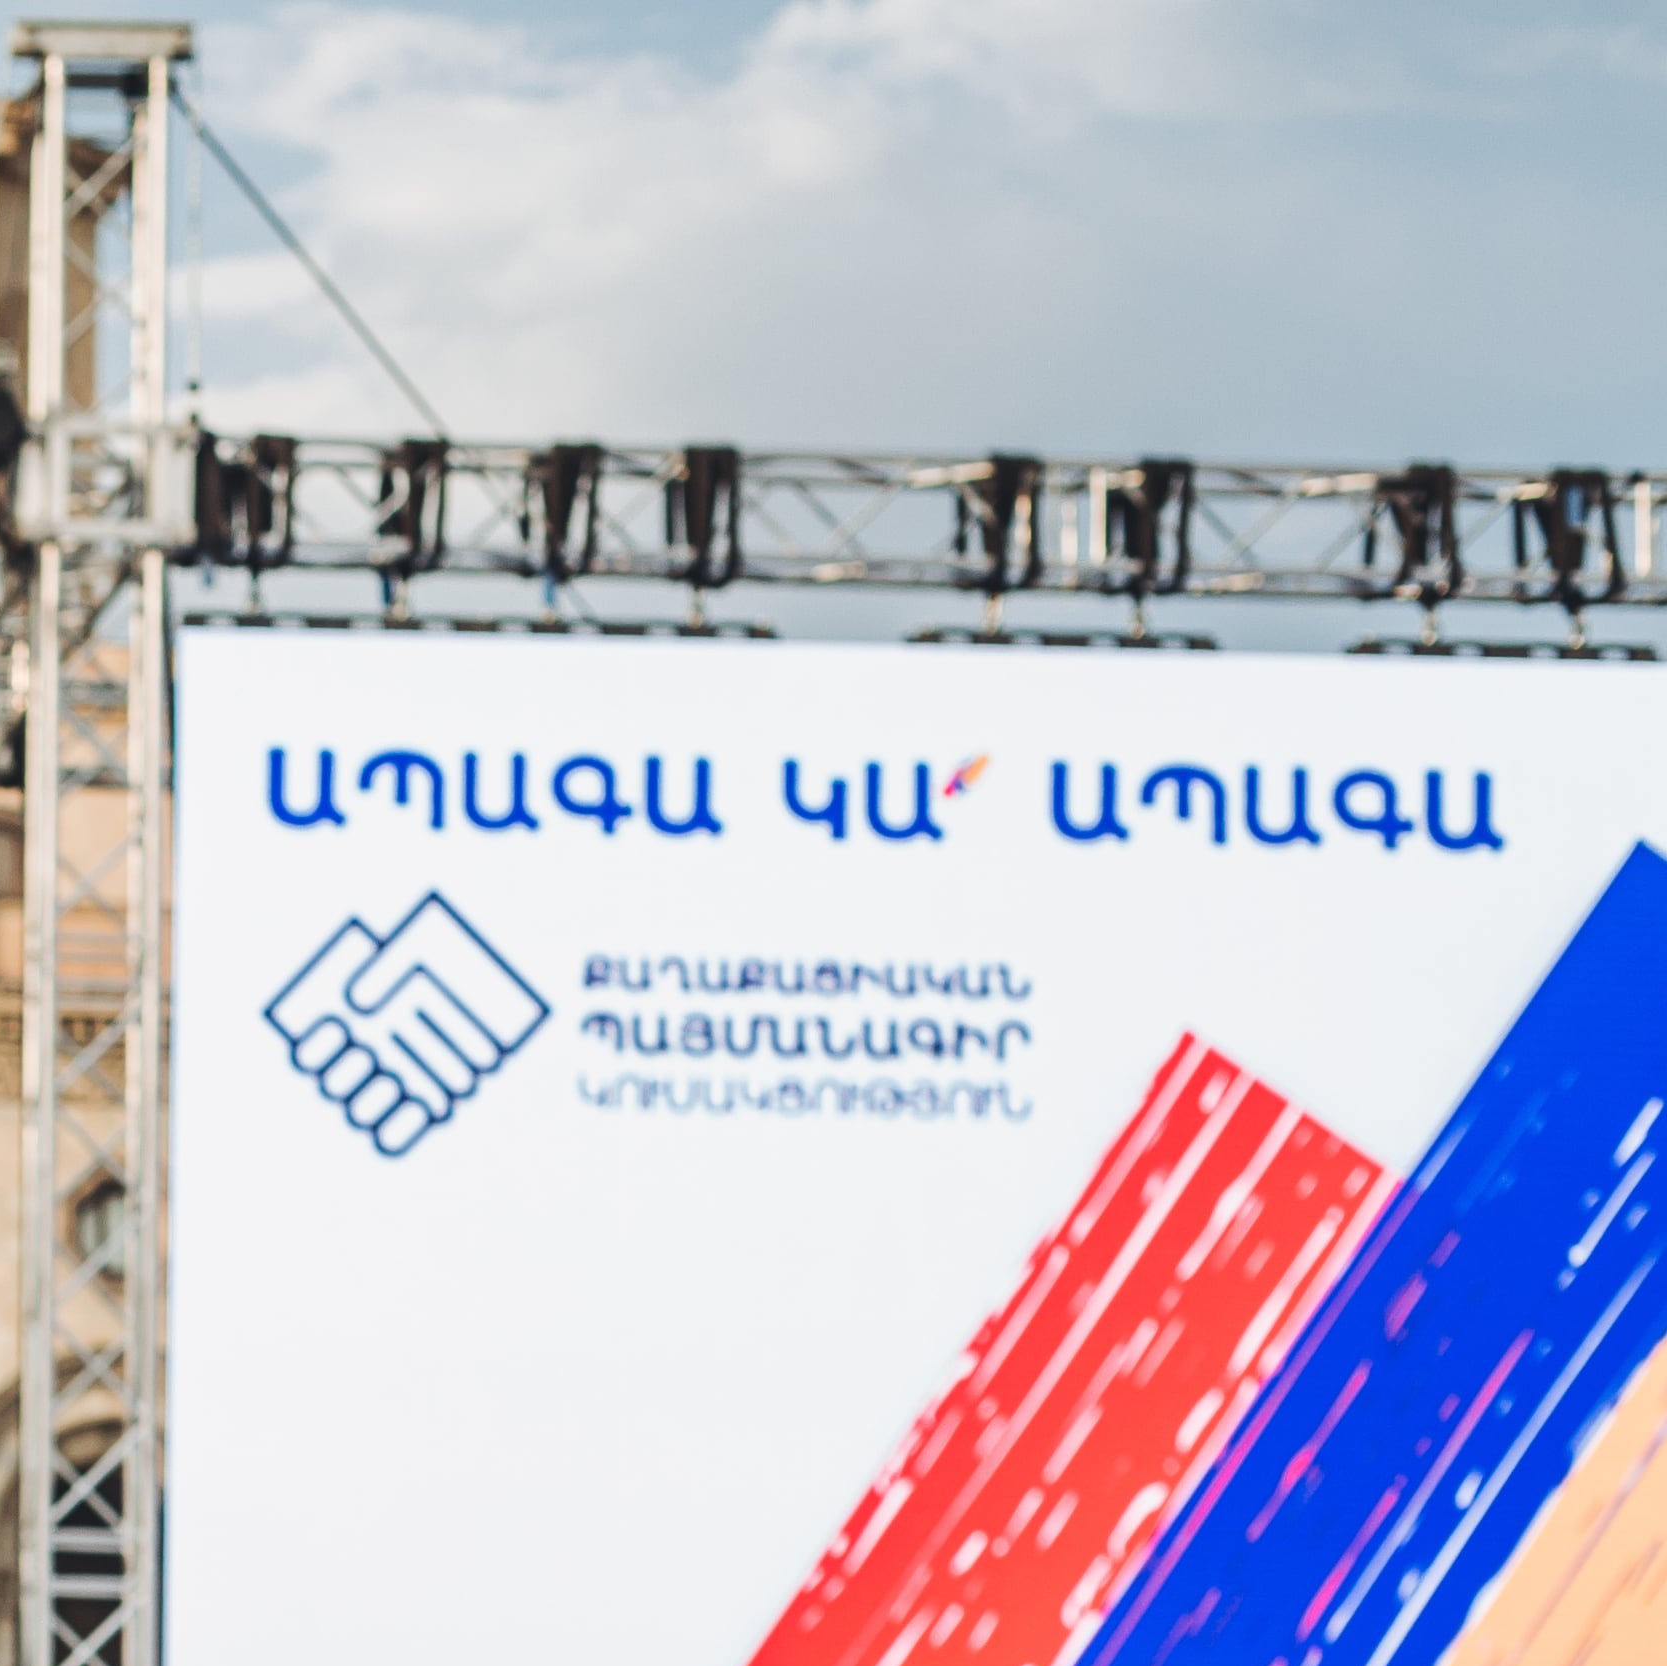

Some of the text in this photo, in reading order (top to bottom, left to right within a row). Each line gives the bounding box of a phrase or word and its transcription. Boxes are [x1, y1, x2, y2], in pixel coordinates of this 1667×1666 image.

[267, 746, 724, 838] ԱՊԱԳԱ
[1050, 759, 1505, 852] ԱՊԱԳԱ
[580, 954, 1033, 1001] ՔԱՂԱՔԱՑԻԱԿԱՆ
[579, 1010, 1033, 1062] ՊԱՅՄԱՆԱԳԻՐ
